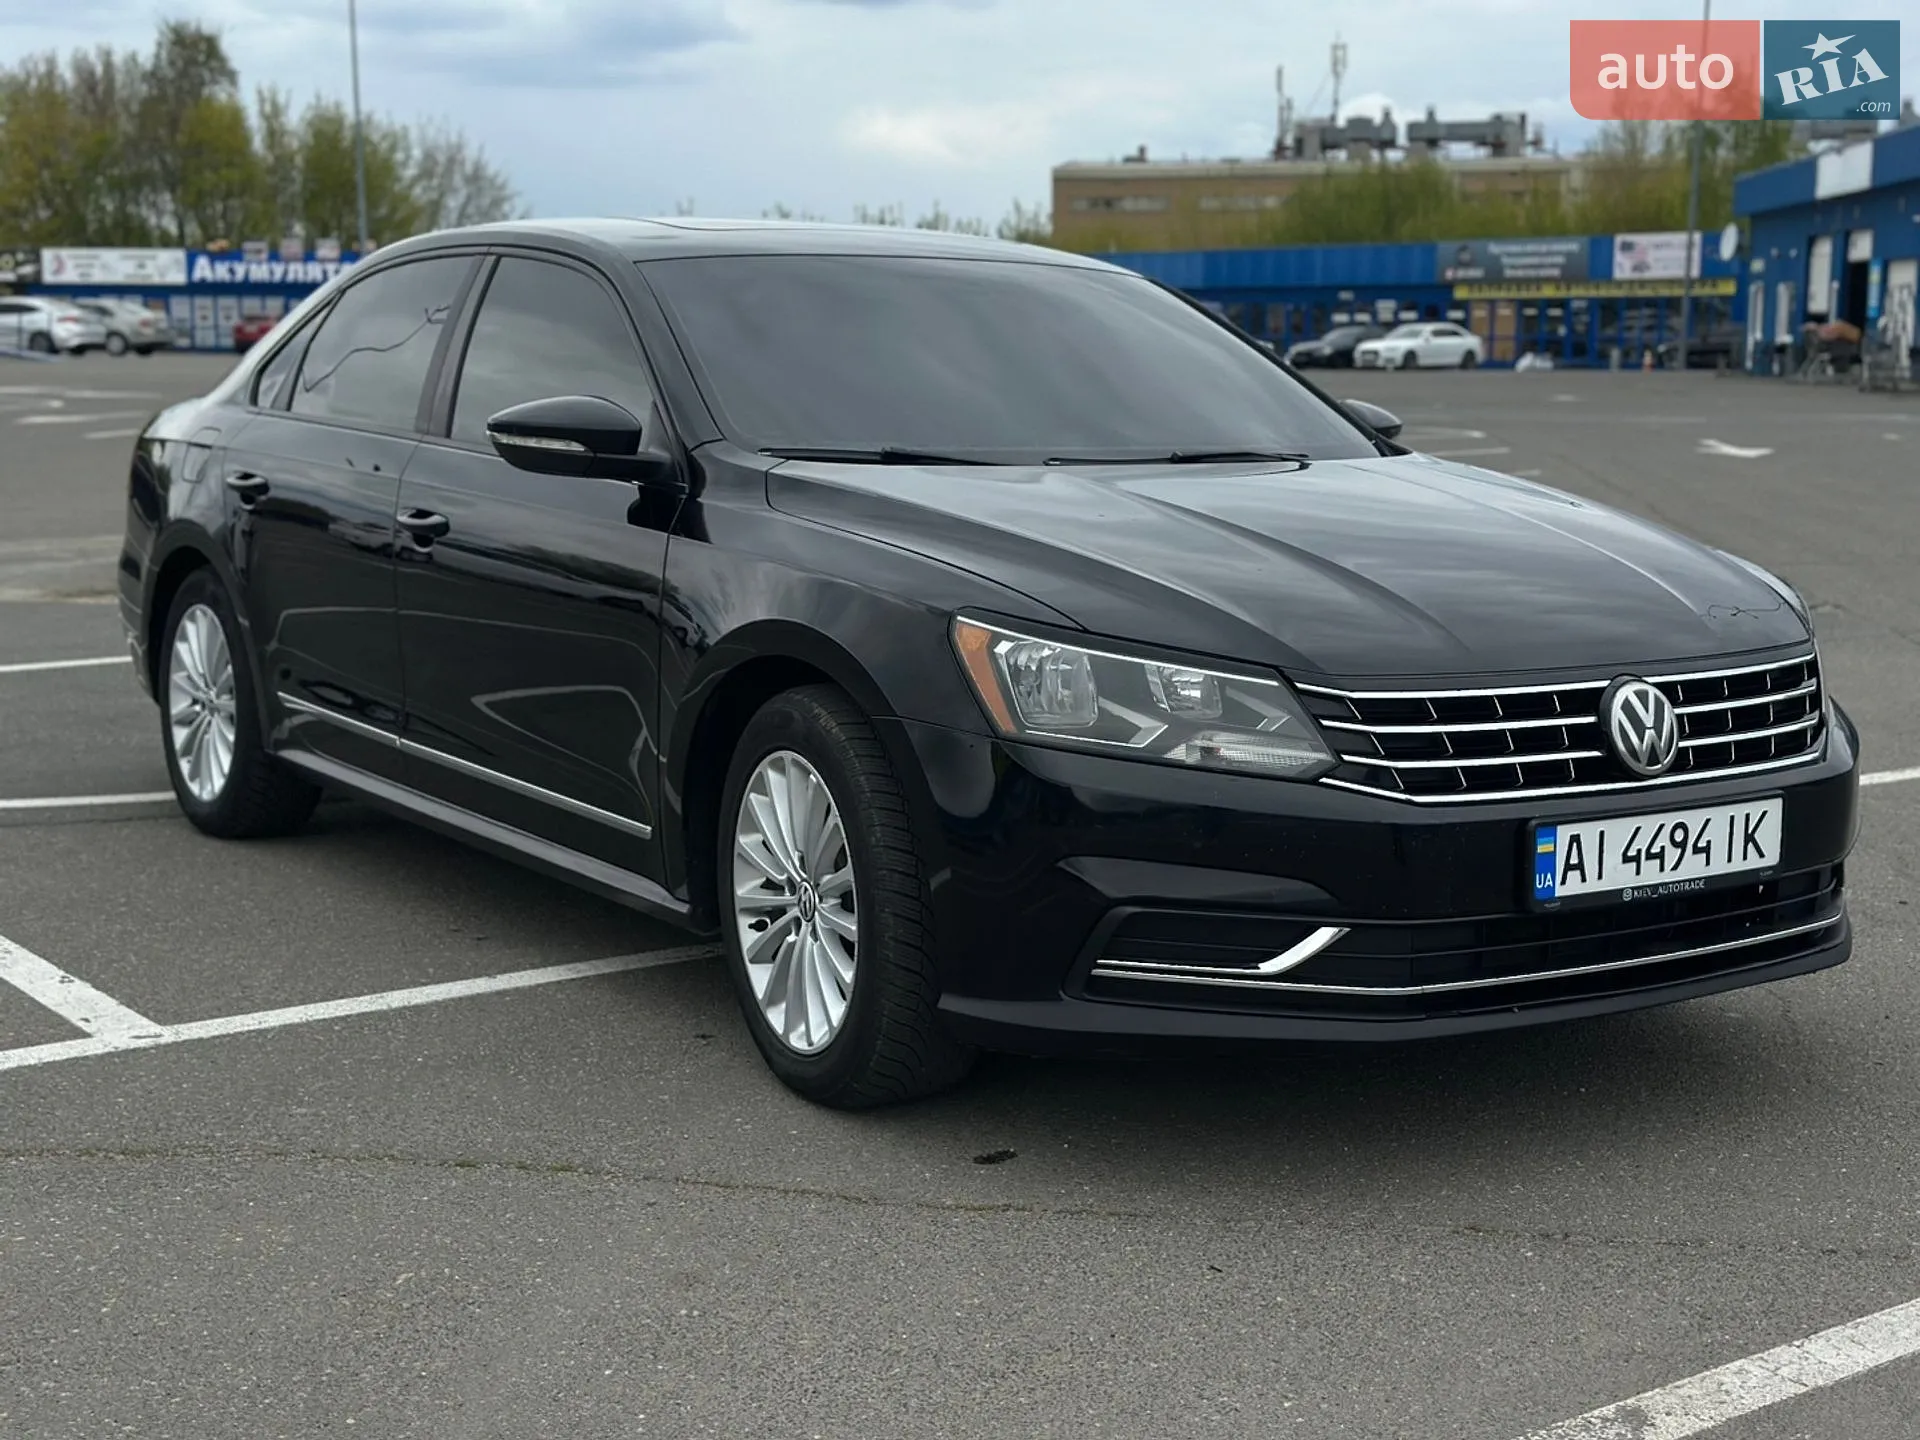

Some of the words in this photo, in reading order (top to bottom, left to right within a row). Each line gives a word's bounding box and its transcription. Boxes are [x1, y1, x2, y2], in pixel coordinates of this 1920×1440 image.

[1560, 829, 1605, 886] AI
[1621, 817, 1712, 876] 4494
[1727, 810, 1769, 863] IK
[1536, 872, 1553, 889] UA
